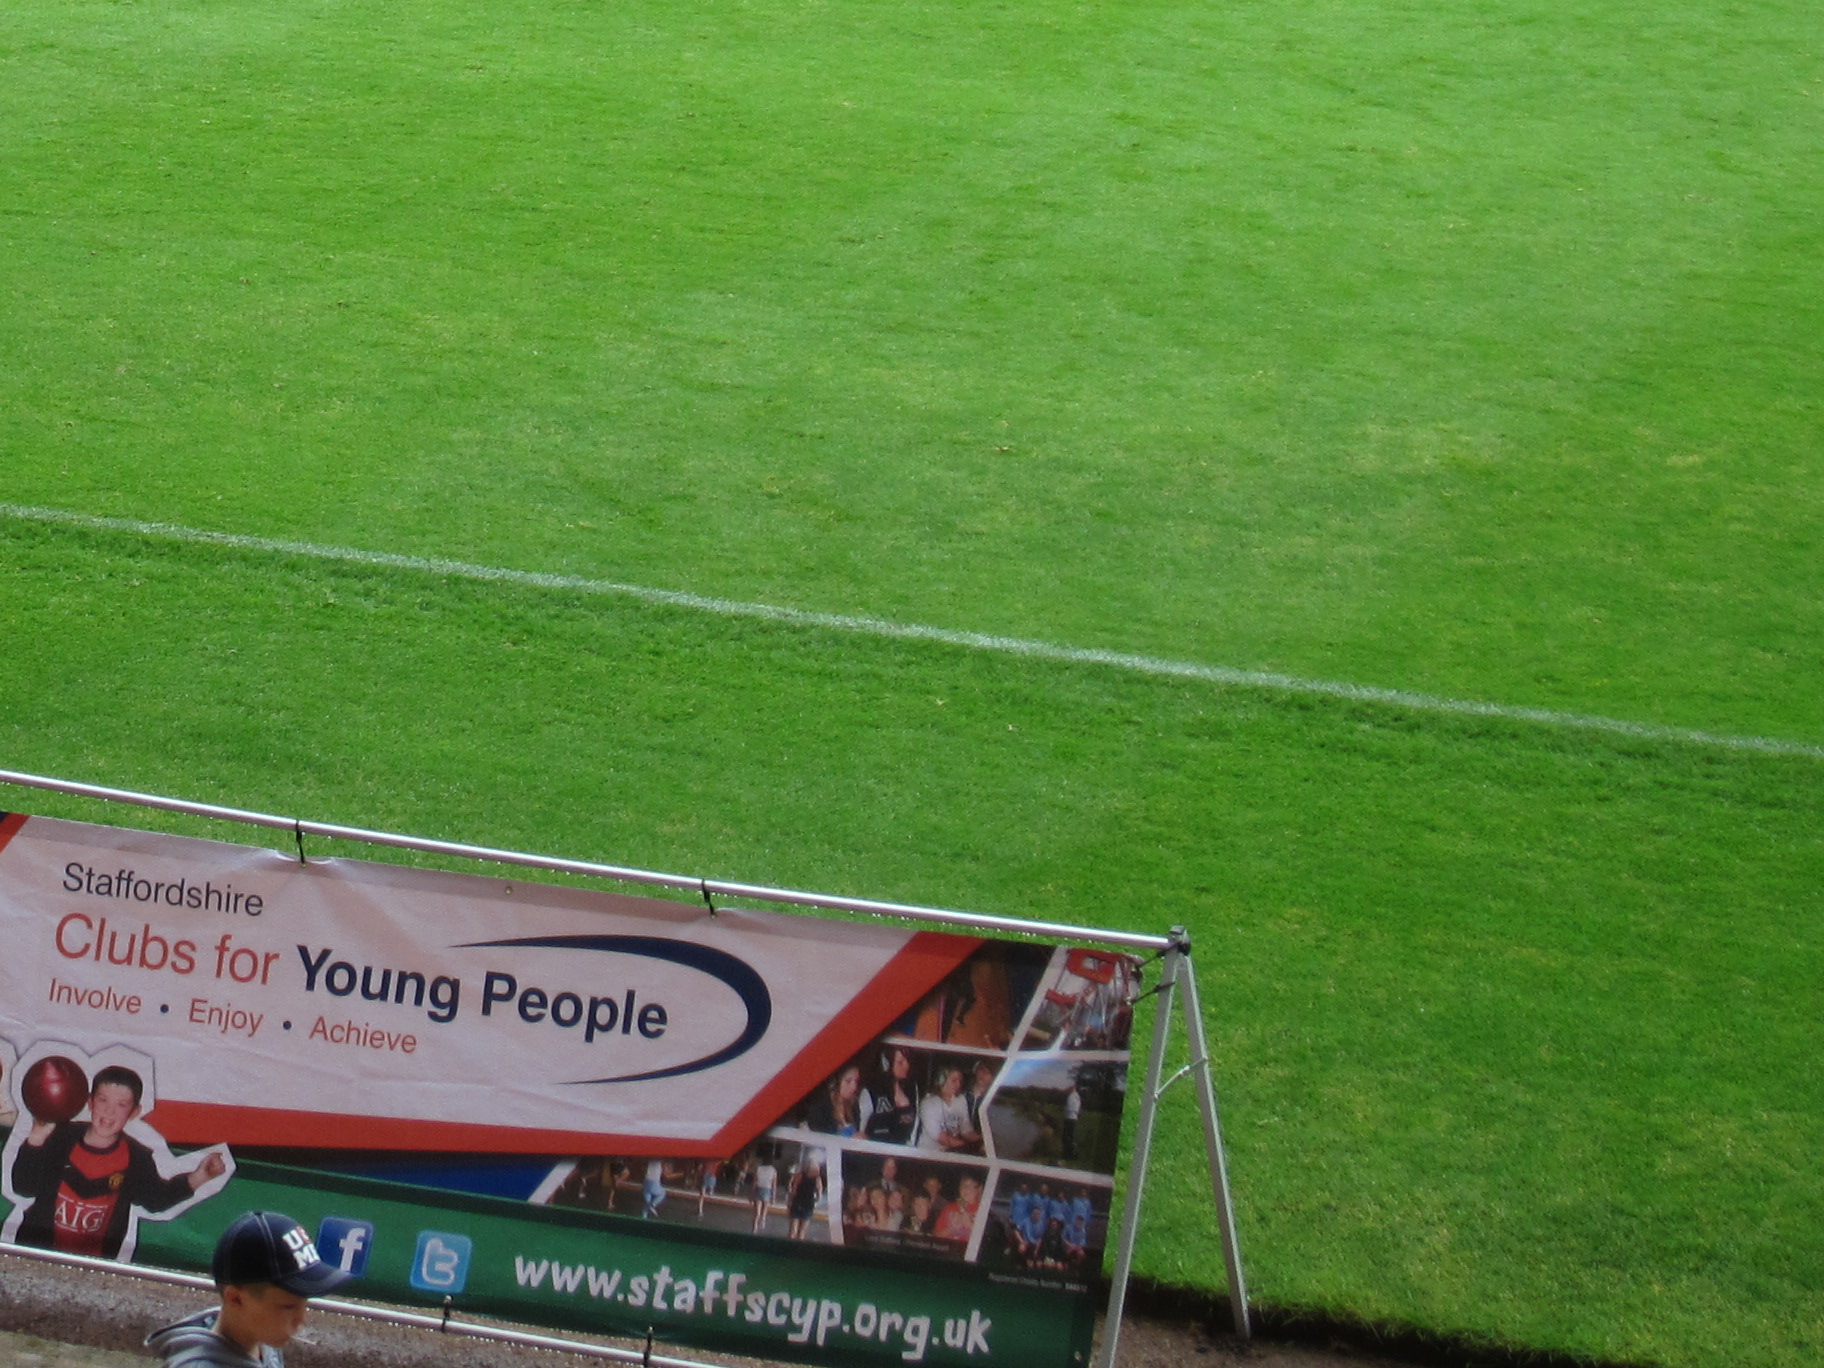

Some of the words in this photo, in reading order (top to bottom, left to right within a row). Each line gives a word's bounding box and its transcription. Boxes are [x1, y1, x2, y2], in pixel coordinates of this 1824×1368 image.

[62, 861, 264, 917] Staffordshire
[55, 912, 197, 975] Clubs
[214, 934, 280, 985] for
[296, 944, 461, 1023] Young
[481, 970, 668, 1043] People
[48, 978, 142, 1014] Involve
[188, 998, 264, 1038] Enjoy
[308, 1015, 418, 1054] Achieve
[55, 1202, 105, 1233] AIG
[514, 1255, 994, 1362] www.staffscyp.org.uk
